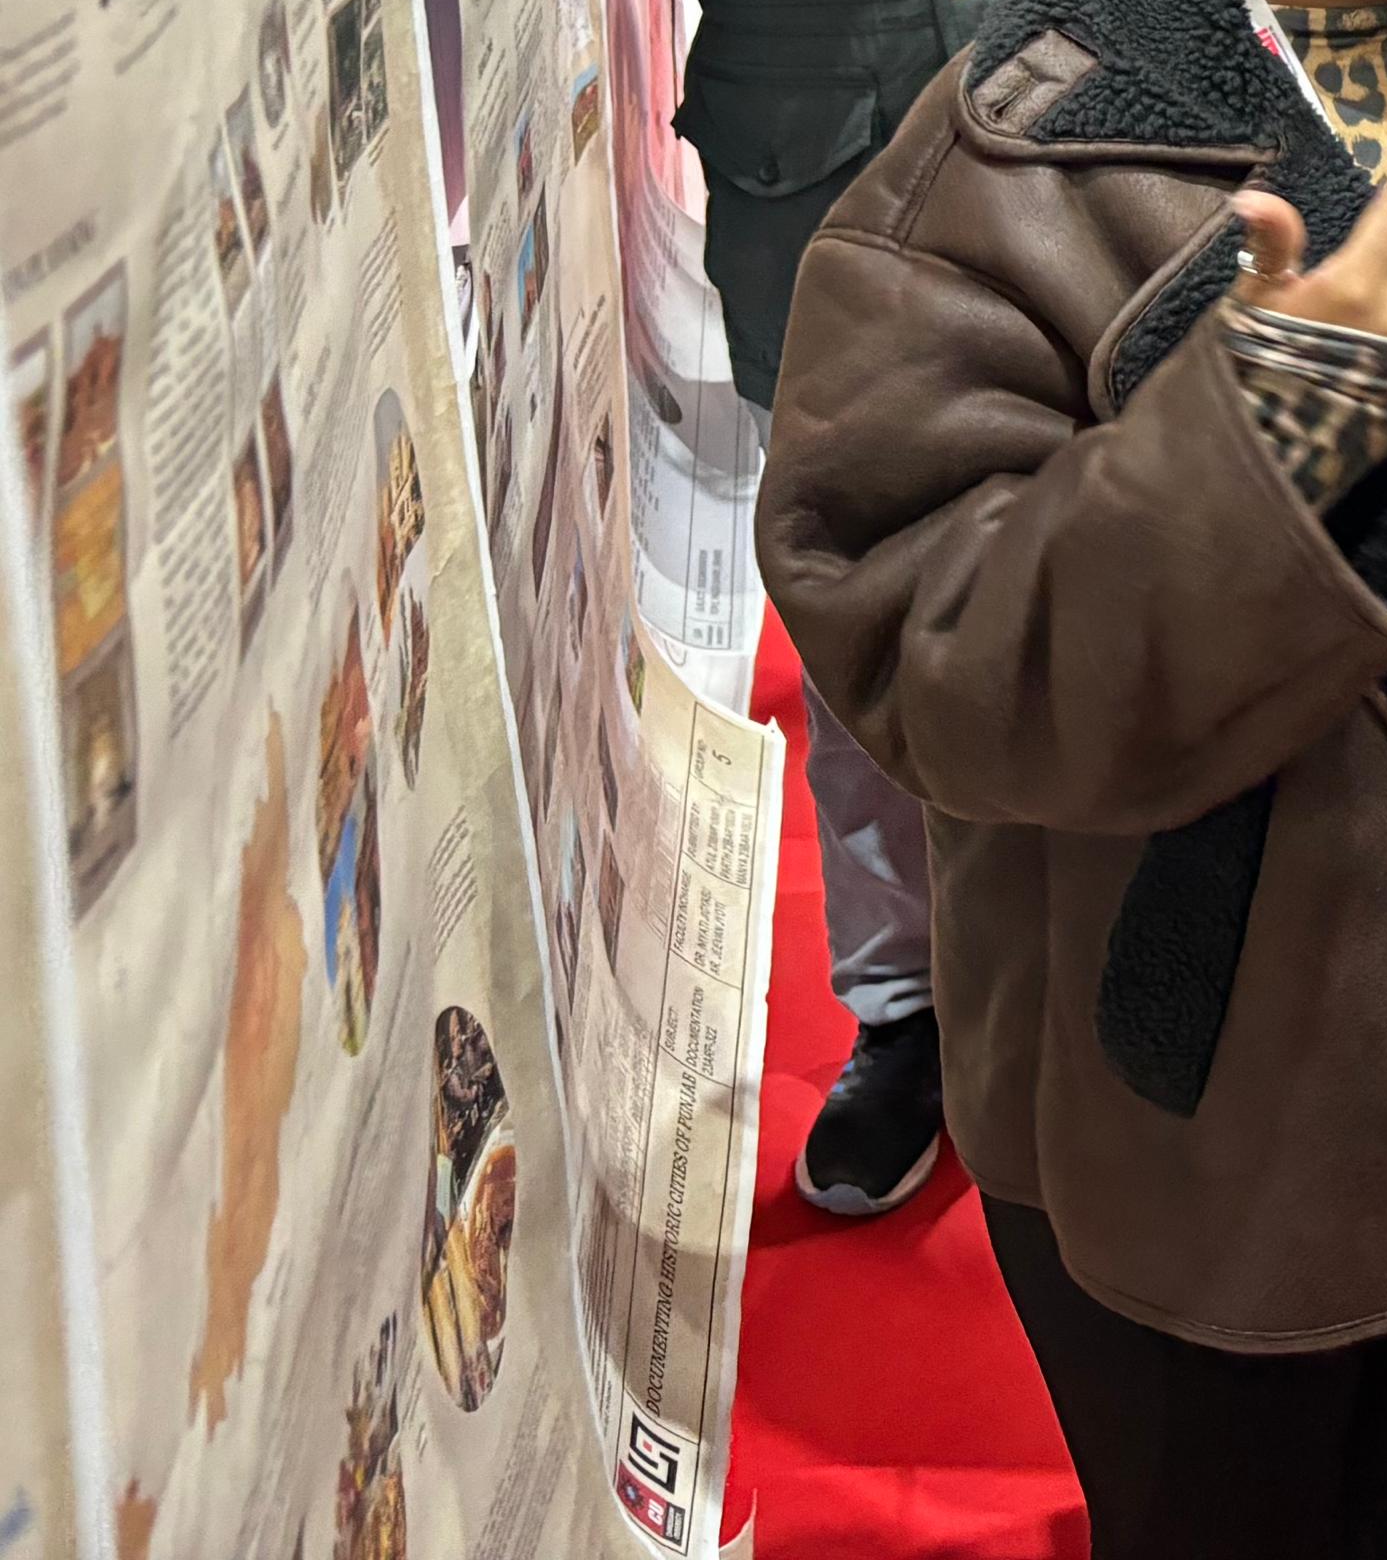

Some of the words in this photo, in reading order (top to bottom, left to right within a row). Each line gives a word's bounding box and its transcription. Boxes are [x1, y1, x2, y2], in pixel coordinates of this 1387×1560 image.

[712, 749, 732, 766] 5
[685, 986, 704, 1067] DOCUMENTATION
[677, 1071, 697, 1131] PUNJAB
[675, 1127, 691, 1152] OF
[670, 1151, 688, 1205] CITIES
[660, 1202, 683, 1284] HISTORIC
[646, 1281, 673, 1417] DOCUMENTING
[647, 1498, 665, 1526] CU
